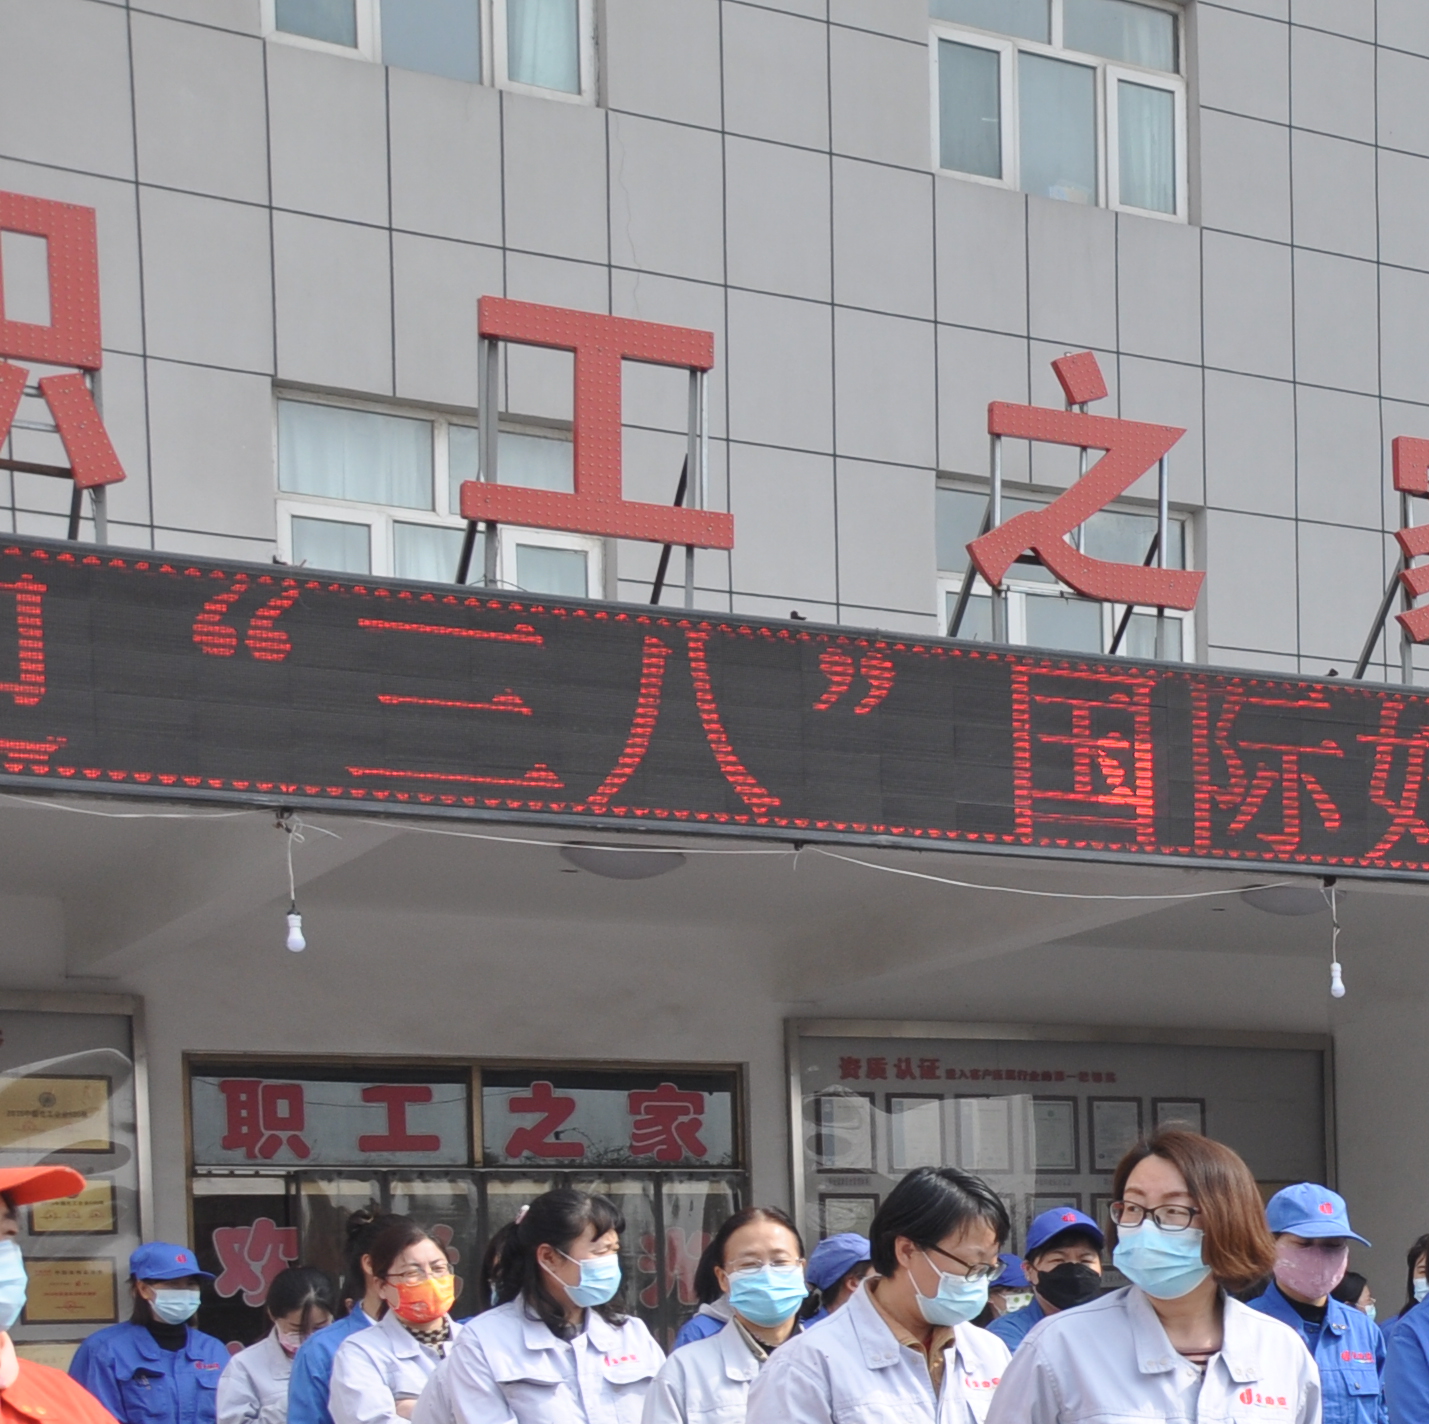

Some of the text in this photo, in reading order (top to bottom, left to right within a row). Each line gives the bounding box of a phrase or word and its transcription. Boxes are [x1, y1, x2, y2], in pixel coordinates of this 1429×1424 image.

[839, 1056, 941, 1081] 资质认证
[218, 1079, 708, 1162] 职工之家
